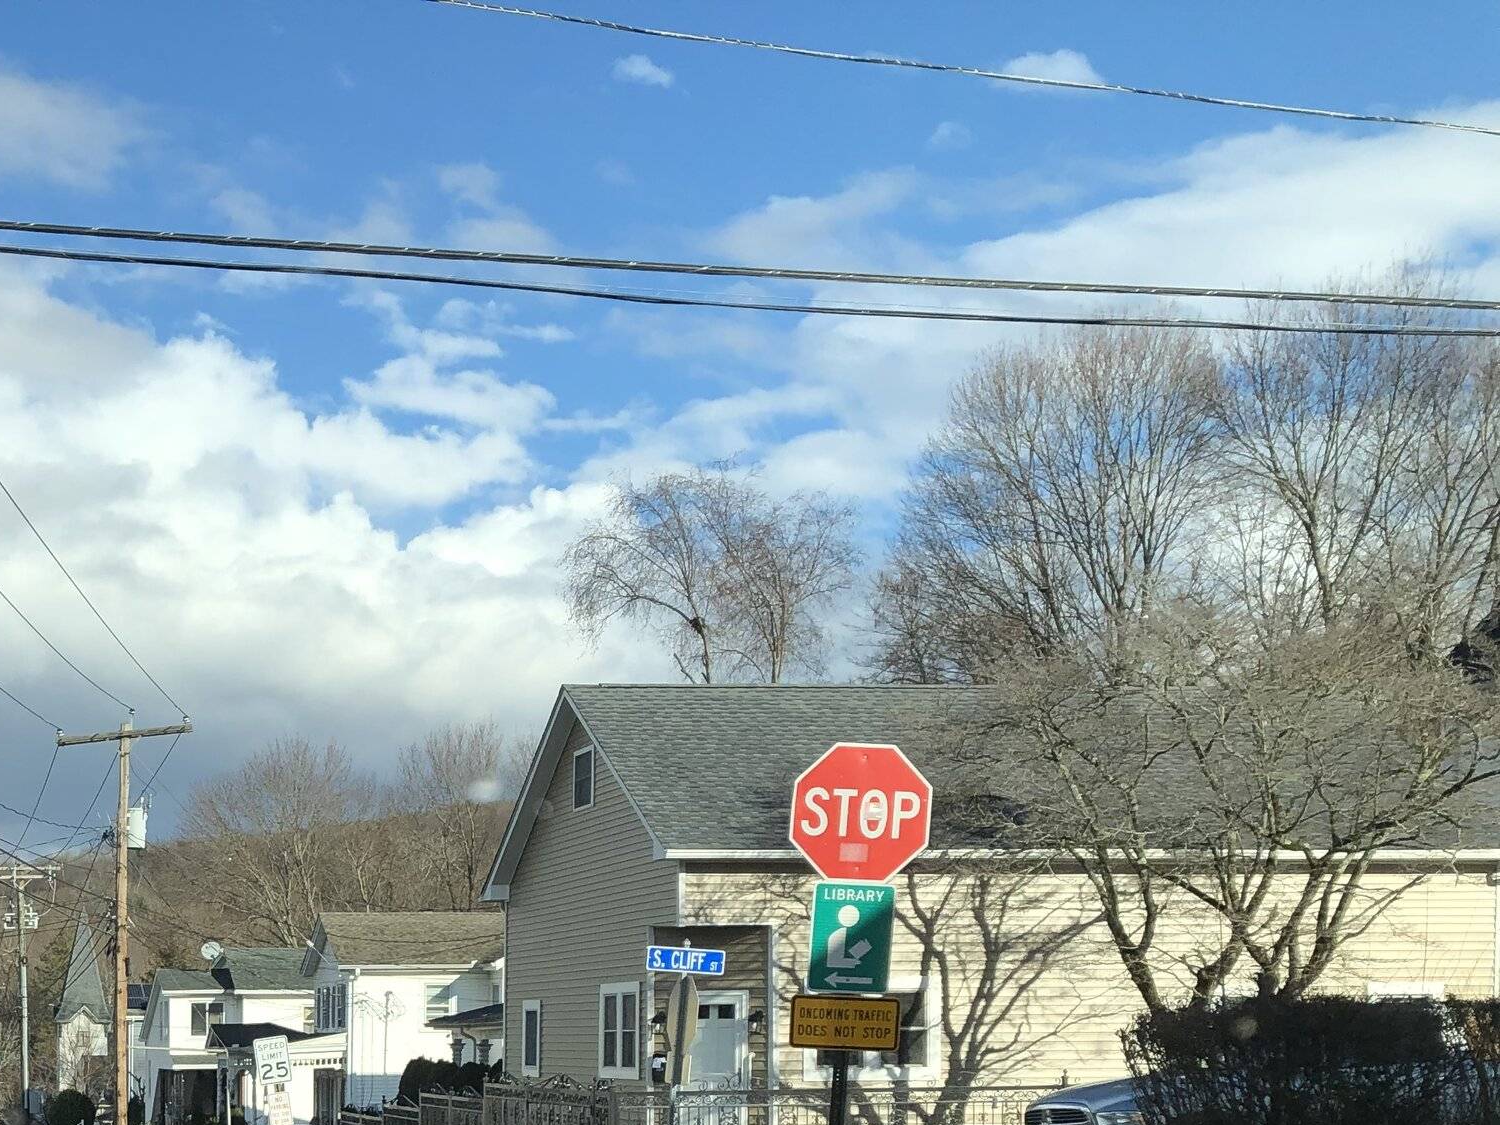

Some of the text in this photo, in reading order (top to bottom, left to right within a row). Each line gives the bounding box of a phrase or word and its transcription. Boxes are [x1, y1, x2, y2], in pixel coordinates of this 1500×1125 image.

[801, 787, 920, 839] STOP
[824, 888, 884, 902] LIBRARY
[652, 949, 719, 971] S. CLIFF ST
[799, 1007, 893, 1022] ONCOMING TRAFFIC
[797, 1024, 891, 1040] DOES NOT STOP
[258, 1042, 284, 1051] SPEED
[262, 1052, 282, 1060] LIMIT
[261, 1061, 288, 1080] 25
